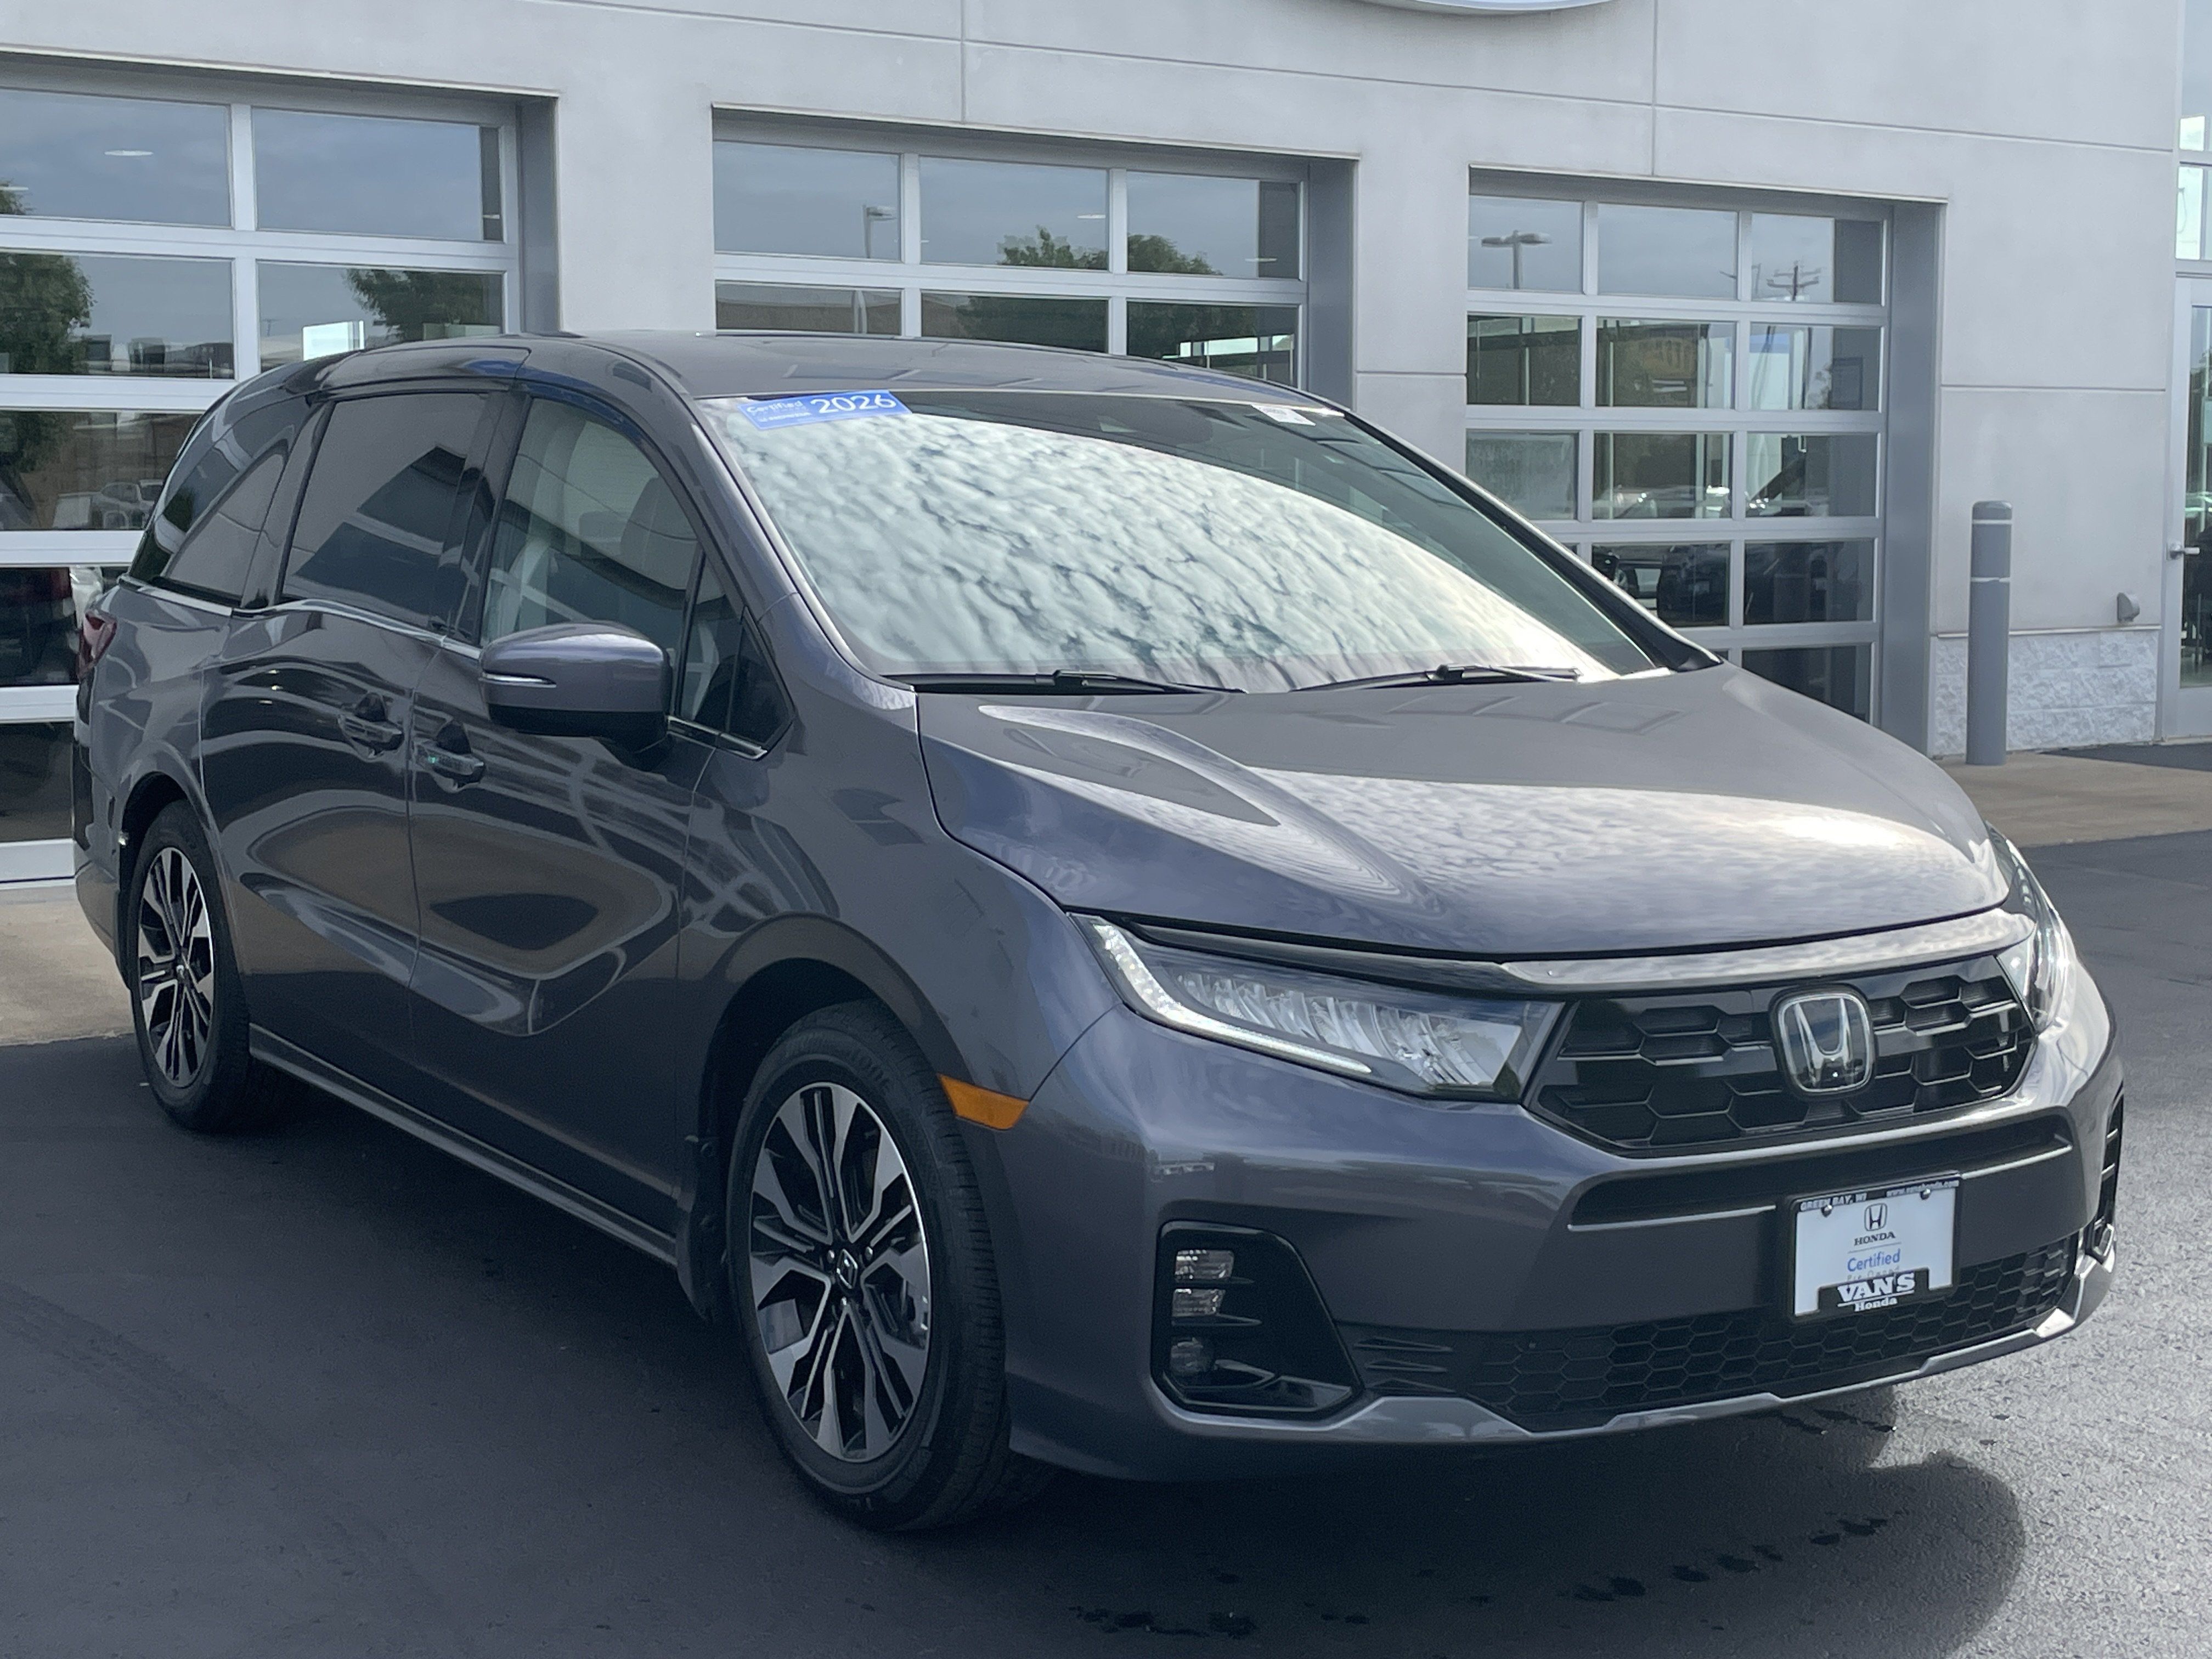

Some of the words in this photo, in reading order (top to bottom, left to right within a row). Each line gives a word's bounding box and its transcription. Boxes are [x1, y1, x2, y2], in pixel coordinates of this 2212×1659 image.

[810, 394, 897, 414] 2026
[1854, 1231, 1895, 1246] HONDA
[1847, 1248, 1901, 1272] Certified
[1854, 1296, 1898, 1312] Honda
